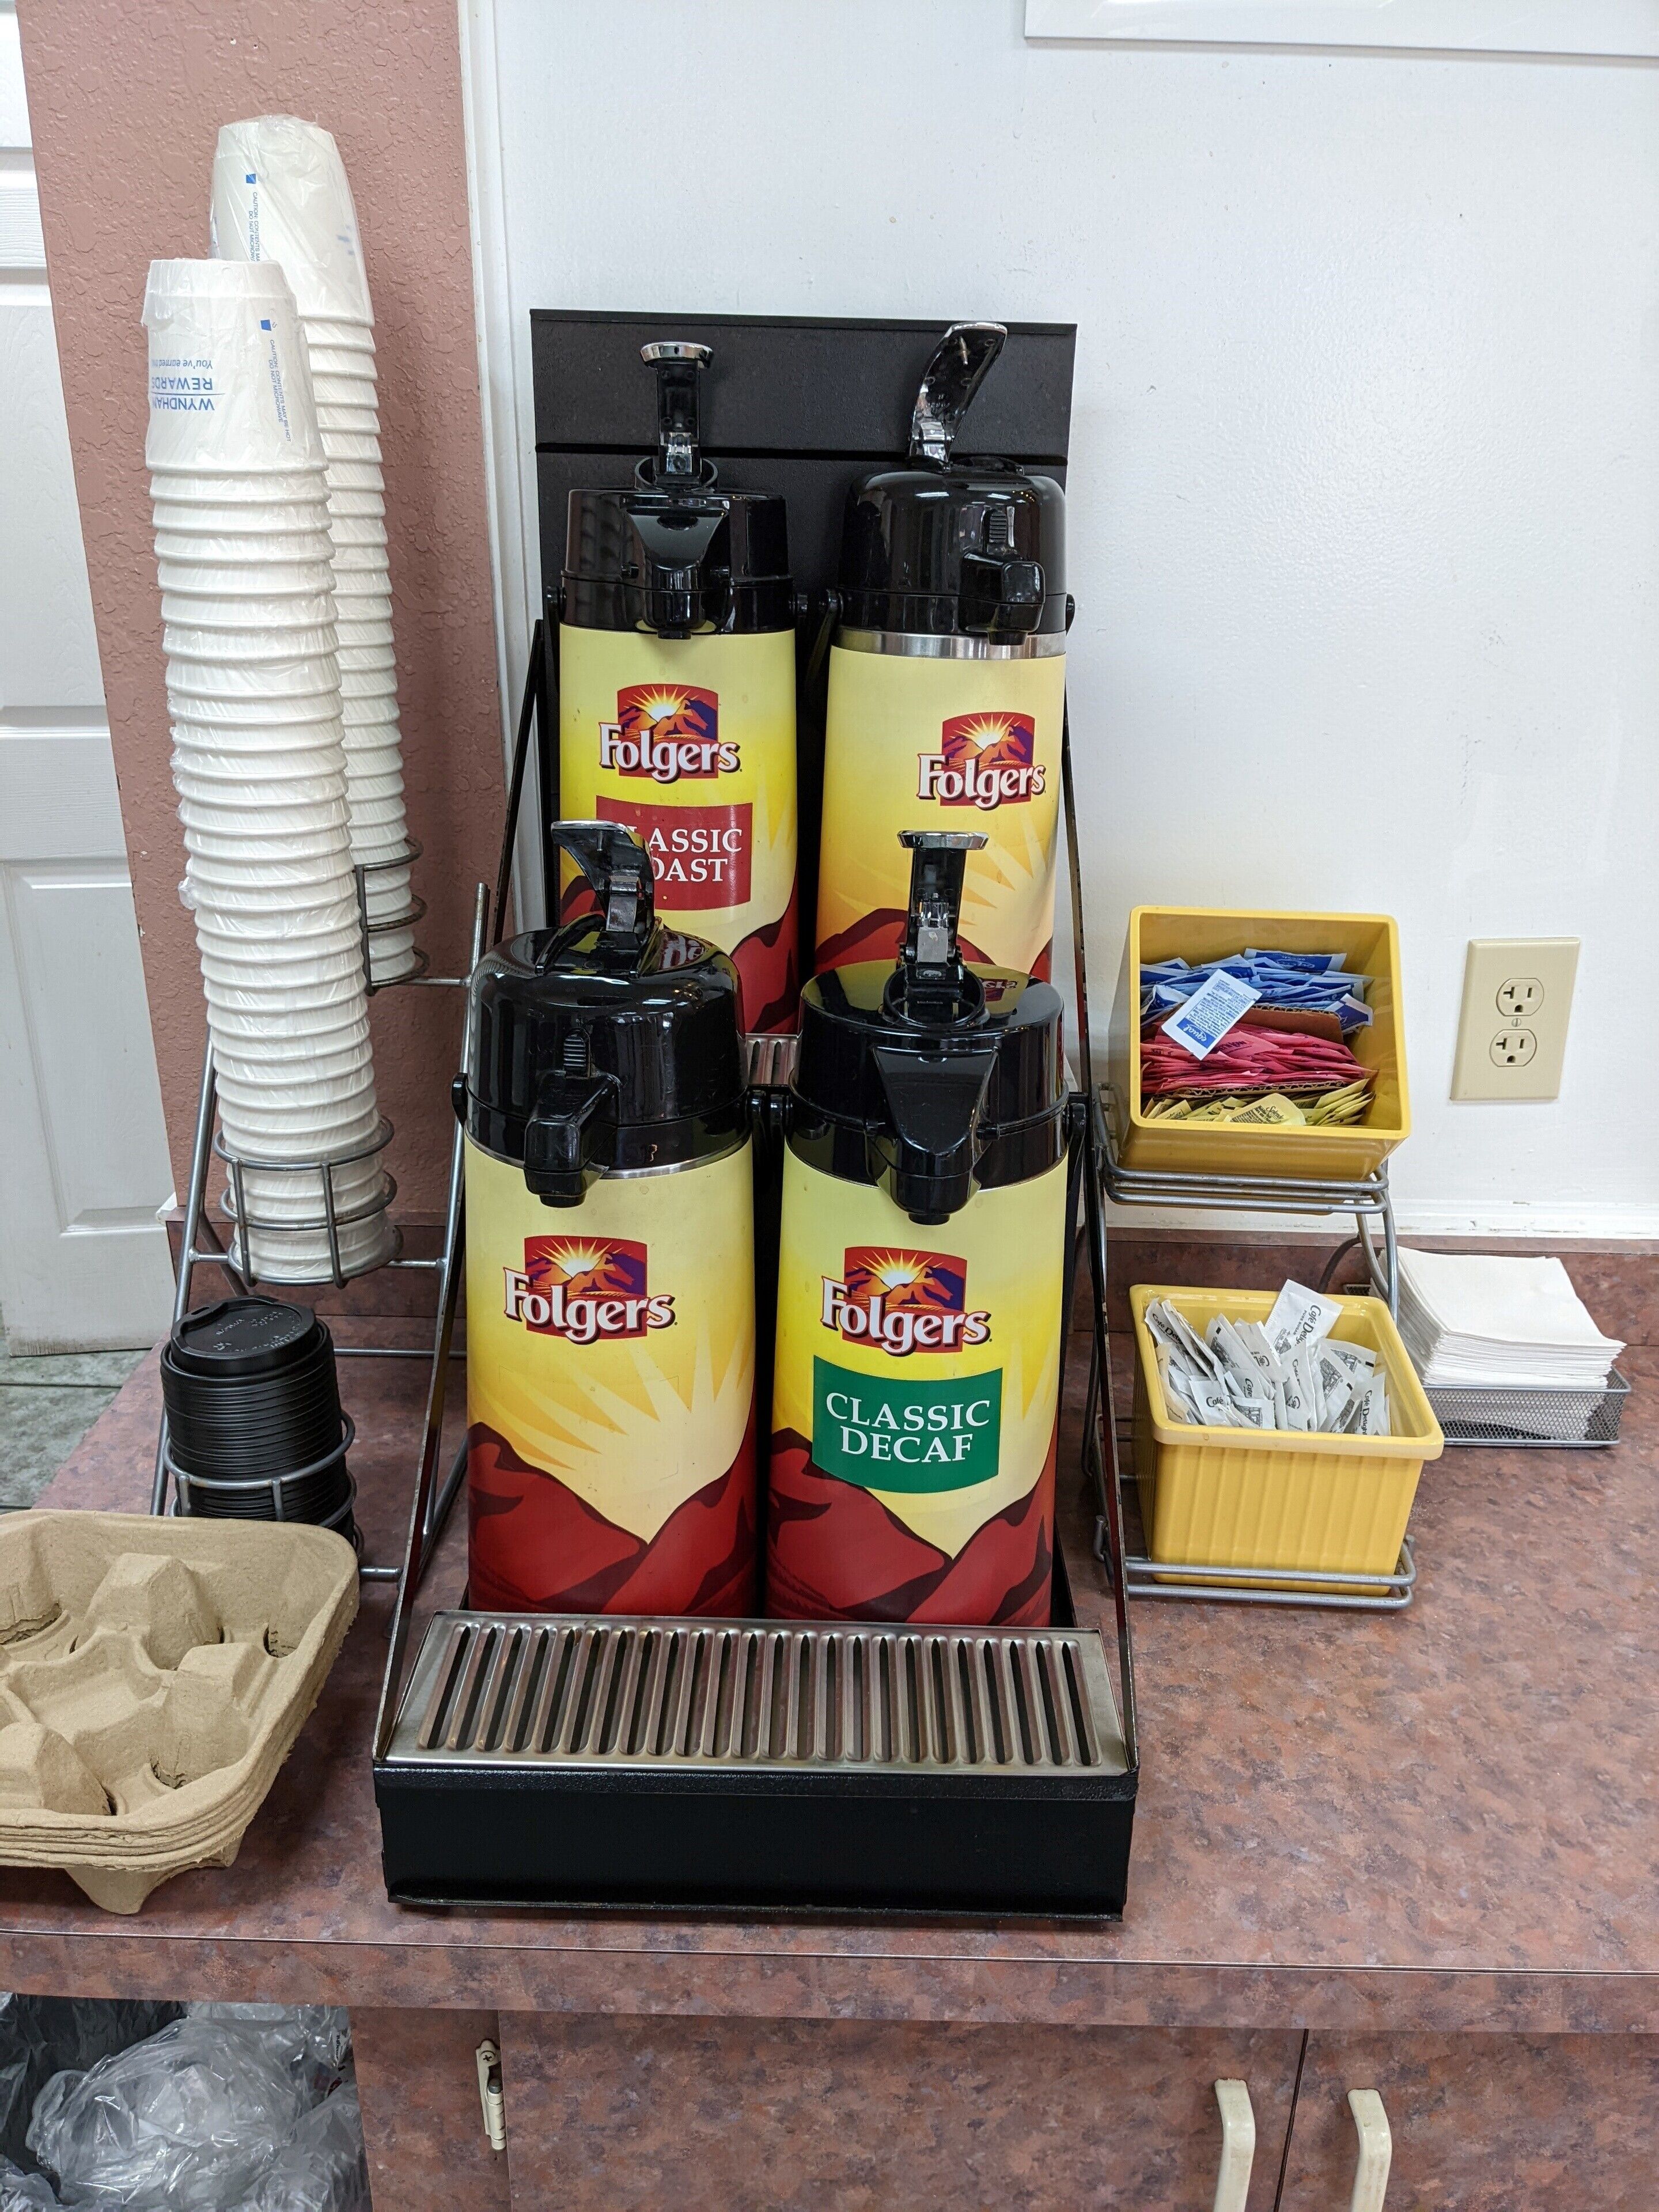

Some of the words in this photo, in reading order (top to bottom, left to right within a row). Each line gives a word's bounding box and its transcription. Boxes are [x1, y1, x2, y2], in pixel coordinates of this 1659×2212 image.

[249, 211, 253, 219] DO
[269, 360, 274, 369] DO
[273, 385, 283, 422] MICROWAVE
[275, 370, 285, 404] CONTENTS
[283, 420, 289, 428] BE
[599, 721, 741, 783] Folgers
[918, 752, 1046, 810] Folgers
[627, 825, 743, 853] ASSIC
[1183, 1024, 1207, 1041] equal
[503, 1266, 677, 1345] Folgers
[821, 1275, 991, 1357] Folgers
[1308, 1305, 1321, 1324] Café
[1294, 1321, 1314, 1346] Delig
[825, 1392, 990, 1431] CLASSIC
[839, 1425, 974, 1463] DECAF
